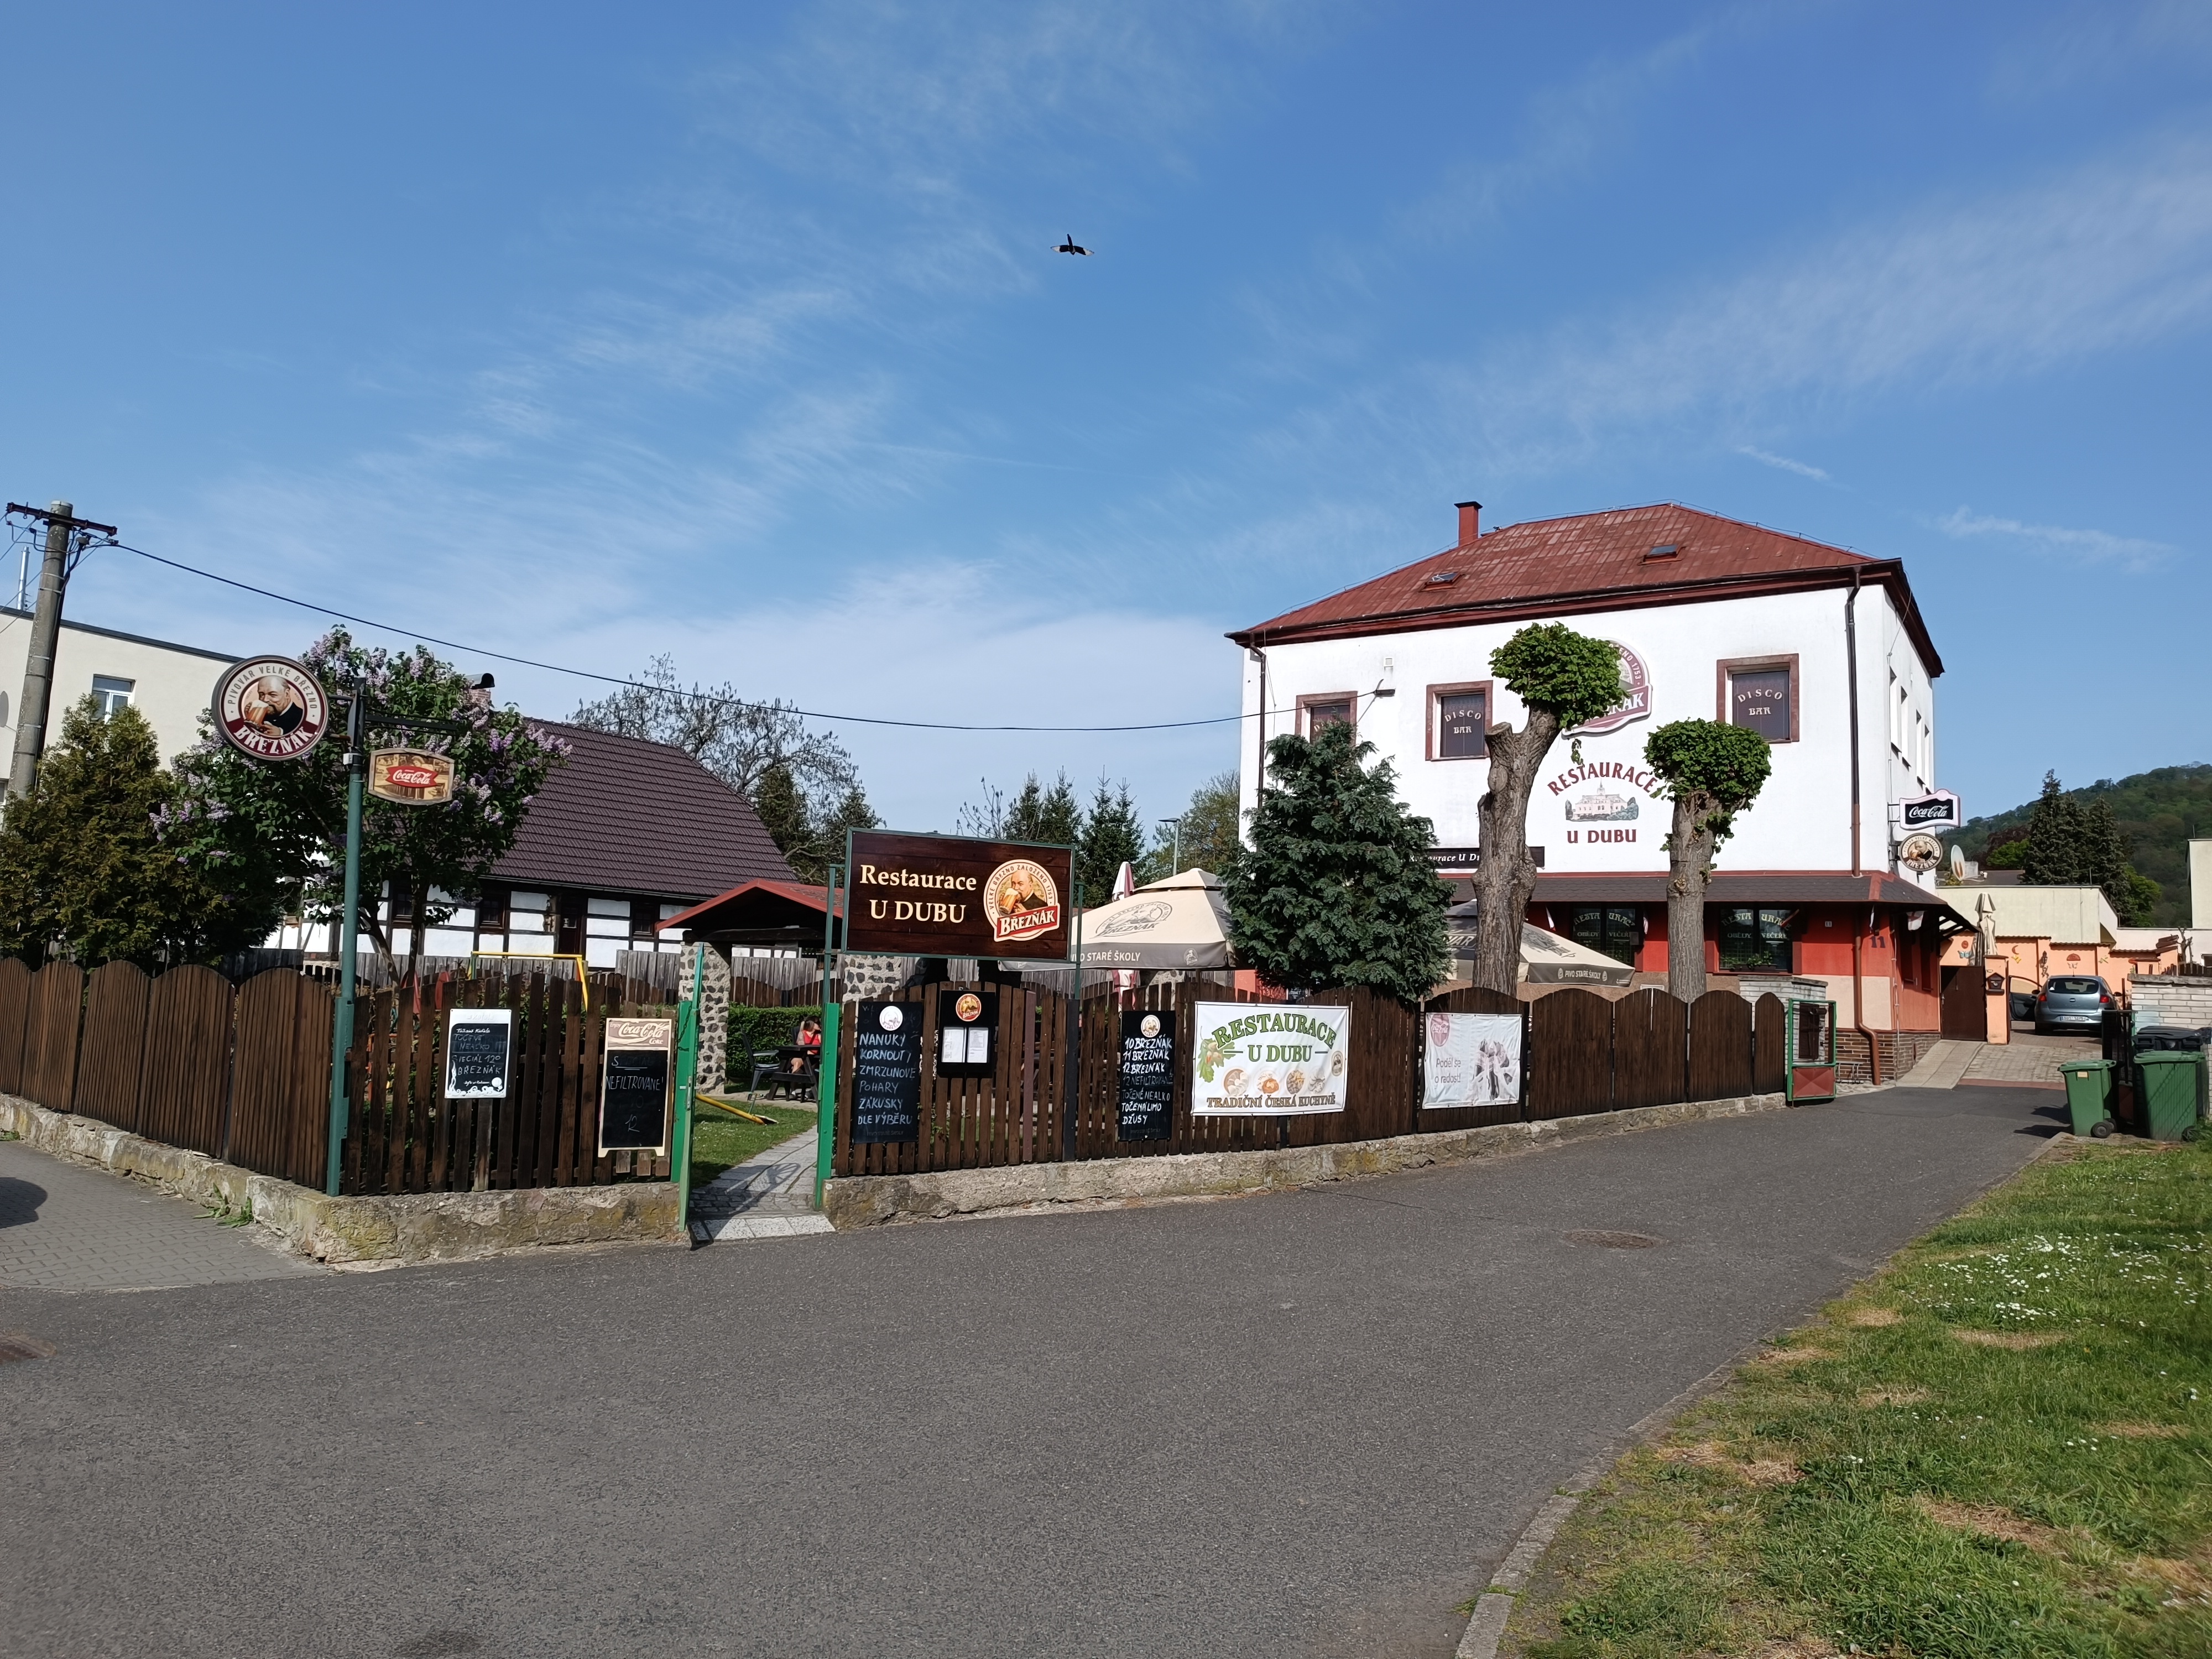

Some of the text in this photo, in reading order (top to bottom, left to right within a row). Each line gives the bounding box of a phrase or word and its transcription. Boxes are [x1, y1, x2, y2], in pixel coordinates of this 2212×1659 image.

[1631, 662, 1642, 680] 1753
[227, 665, 317, 709] PIVOVAR VELKÉ BŘEZNO
[1737, 689, 1783, 703] DISCO
[1444, 709, 1481, 722] DISCO
[1749, 707, 1771, 716] BAR
[233, 725, 314, 754] BŘEZŇÁK
[1547, 762, 1658, 796] RESTAURACE
[1908, 805, 1950, 818] Coca-Cola
[1567, 829, 1637, 844] U DUBU
[1458, 853, 1466, 861] U
[859, 864, 977, 891] Restaurace
[993, 865, 1014, 886] BŘEZNO
[1016, 864, 1047, 884] ZALOŽENO
[869, 899, 967, 924] U DUBU
[999, 909, 1055, 936] BŘEZŇÁK
[1087, 950, 1112, 962] STARÉ
[1113, 950, 1141, 962] ŠKOLY
[1211, 1013, 1337, 1050] RESTAURACE
[859, 1032, 906, 1047] NANUKY
[1125, 1037, 1135, 1050] 10
[1123, 1050, 1132, 1061] 11
[1247, 1044, 1313, 1062] U DUBU
[1123, 1062, 1131, 1073] 12
[1436, 1057, 1461, 1068] Poděl se
[1434, 1073, 1461, 1084] o radost!
[1145, 1091, 1171, 1102] NEALKO
[1206, 1092, 1336, 1108] TRADIČNÍ ČESKÁ KUCHYNĚ
[1147, 1102, 1162, 1112] LIMO
[858, 1111, 913, 1125] DLE VÝBĚRU
